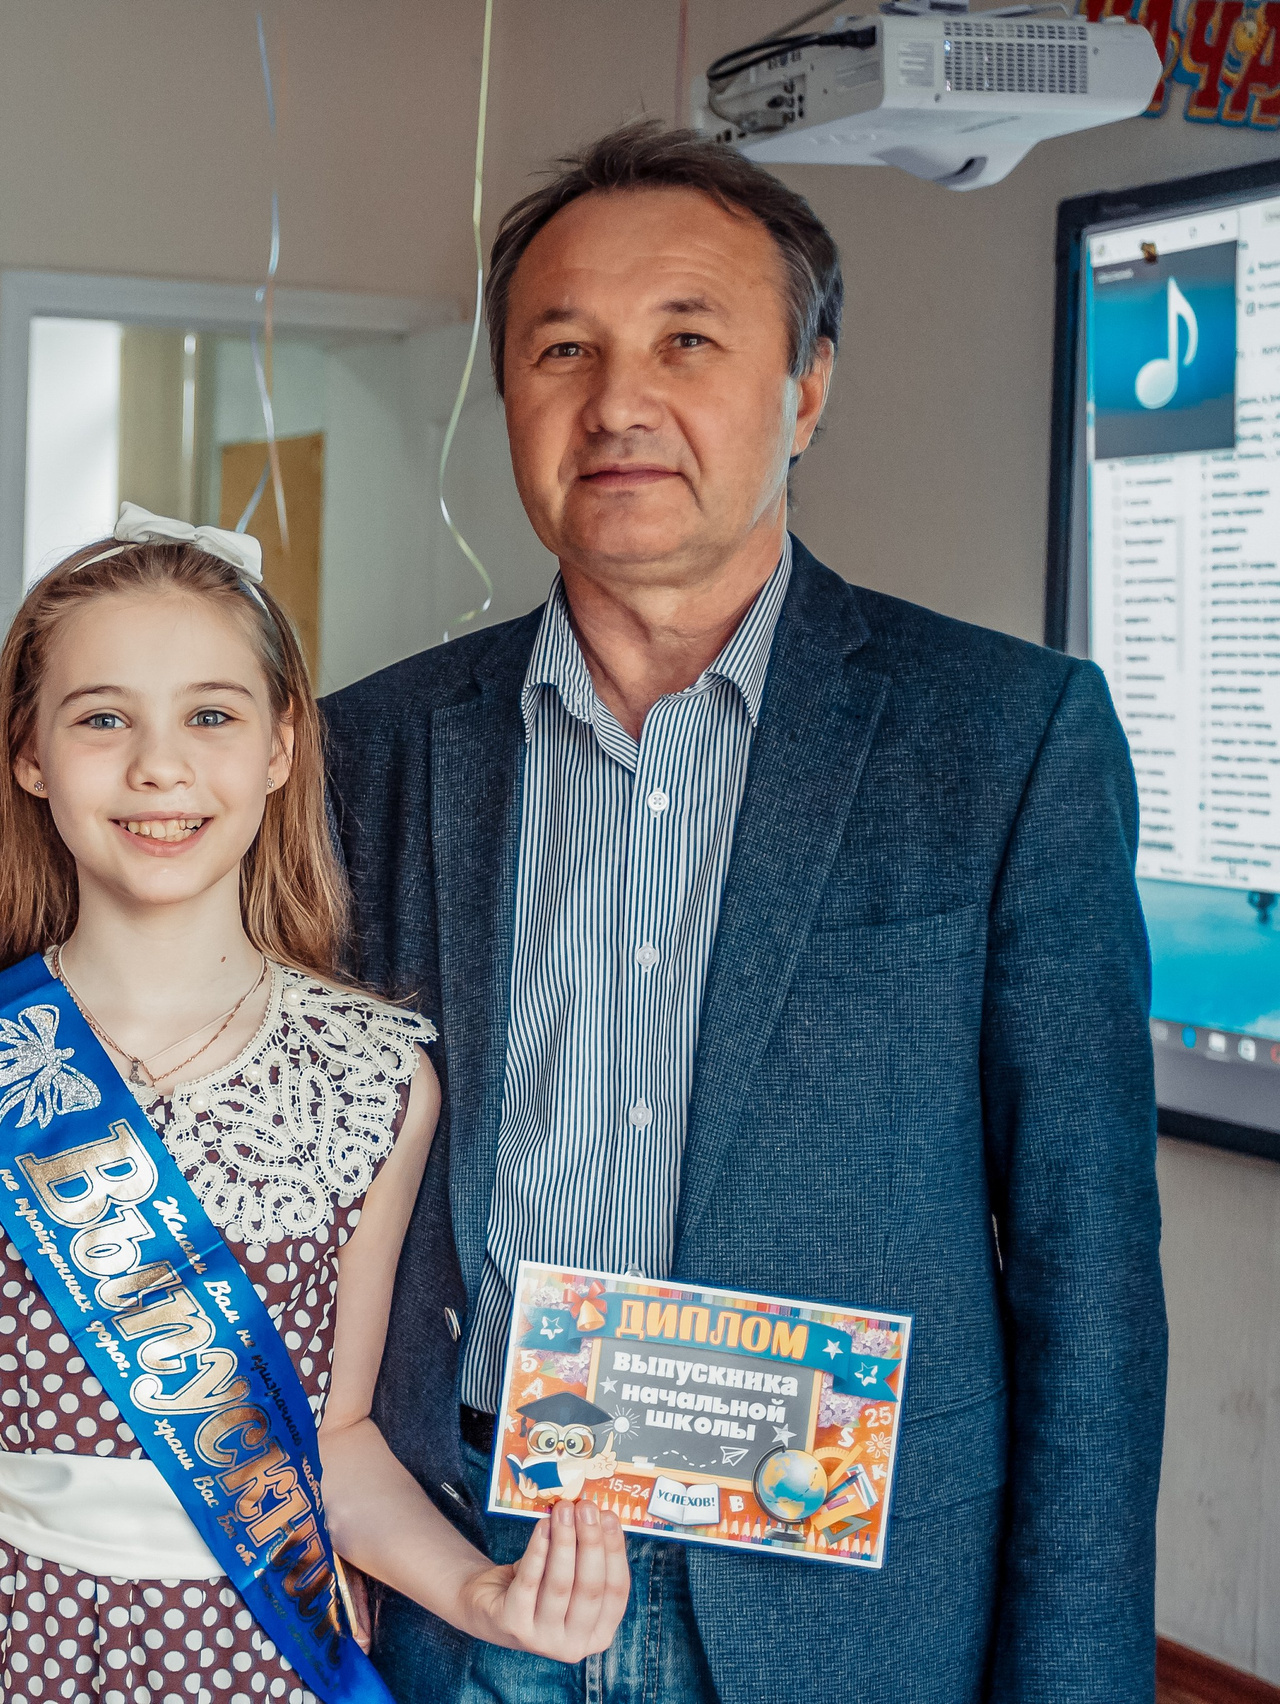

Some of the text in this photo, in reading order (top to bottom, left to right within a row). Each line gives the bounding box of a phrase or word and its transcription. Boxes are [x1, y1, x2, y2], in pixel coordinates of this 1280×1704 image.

[14, 1198, 94, 1313] пройденных
[153, 1196, 207, 1275] Желаем
[203, 1281, 240, 1324] Вам
[615, 1300, 810, 1360] ДИПЛОМ
[520, 1350, 538, 1373] 5
[613, 1351, 799, 1398] выпускника
[621, 1383, 787, 1424] начальной
[645, 1409, 757, 1442] школы
[864, 1406, 892, 1428] 25
[153, 1418, 195, 1471] храни
[192, 1475, 219, 1508] Вас
[658, 1489, 716, 1507] УСПЕХОВ!
